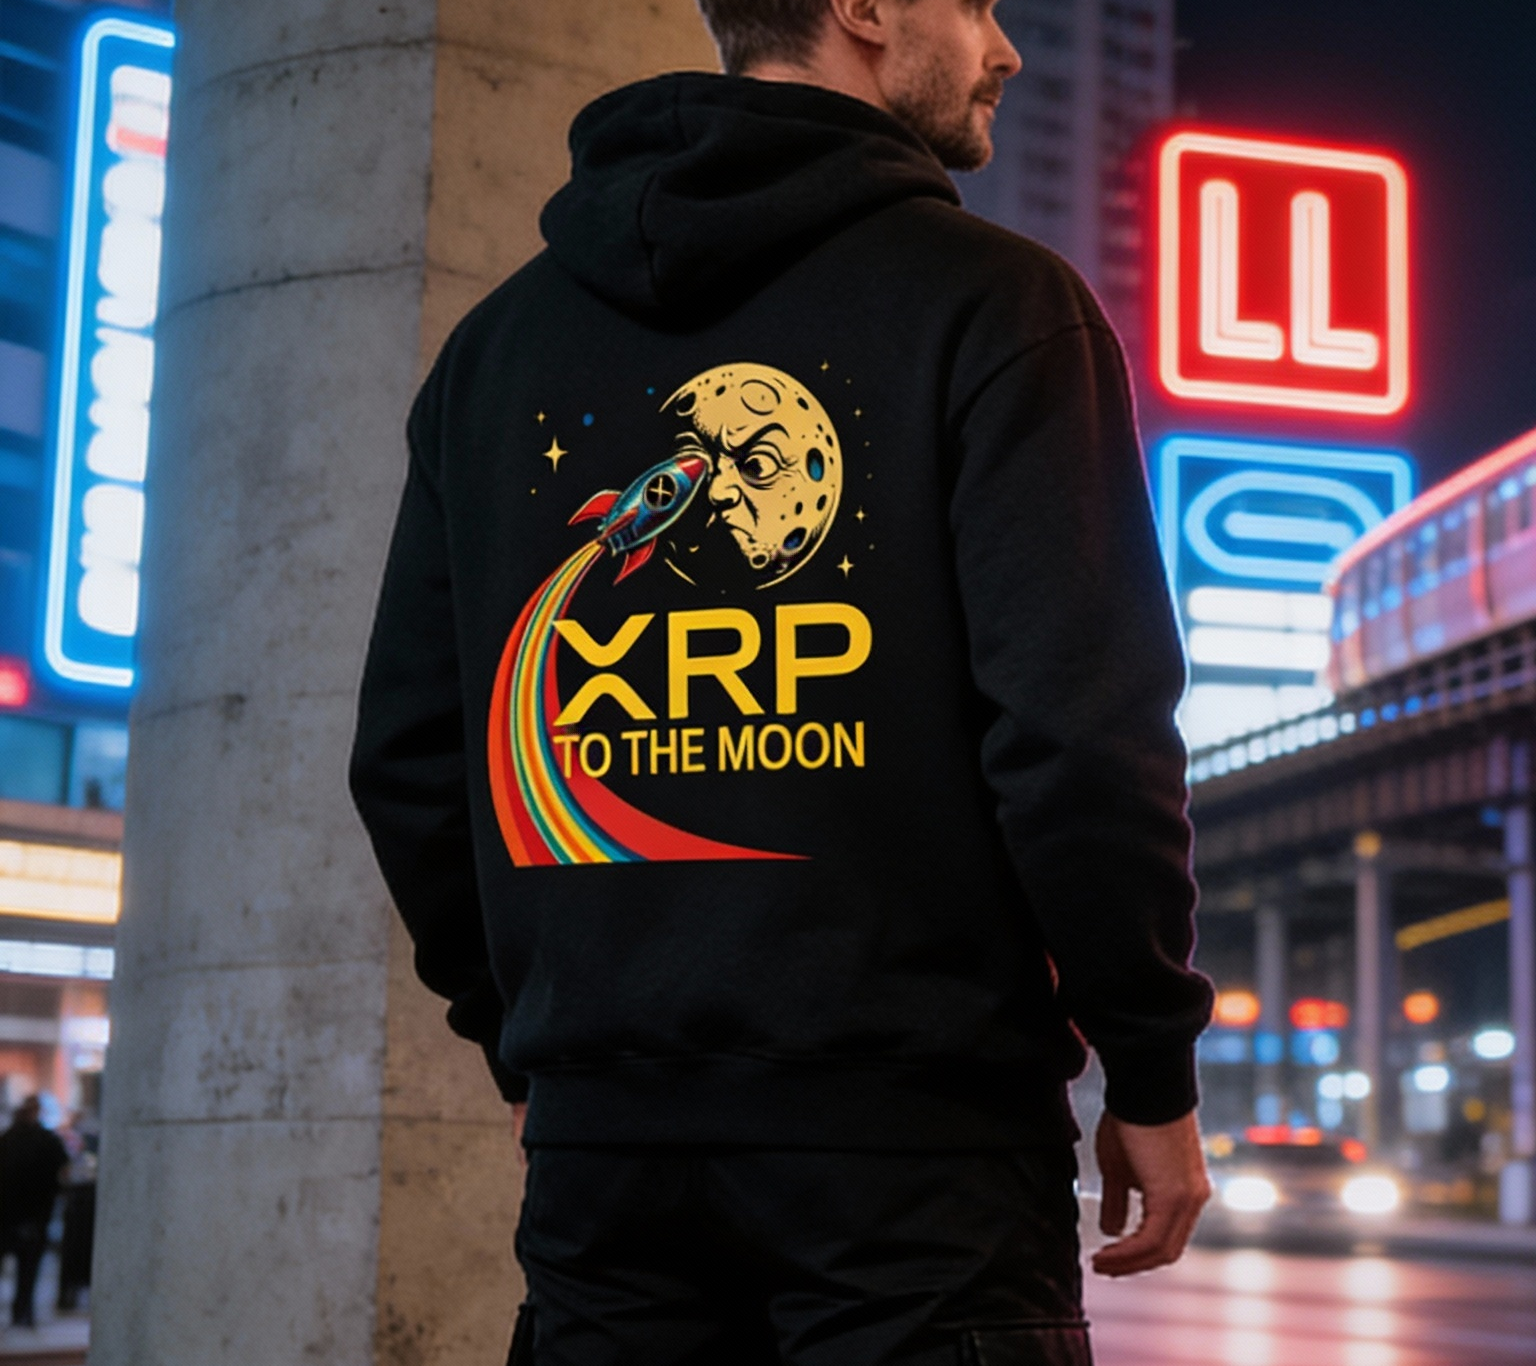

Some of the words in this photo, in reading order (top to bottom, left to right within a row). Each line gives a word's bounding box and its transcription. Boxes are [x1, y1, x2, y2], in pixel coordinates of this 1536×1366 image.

[553, 602, 872, 726] XRP
[553, 733, 612, 779] TO
[621, 729, 706, 776] THE
[718, 721, 866, 772] MOON
